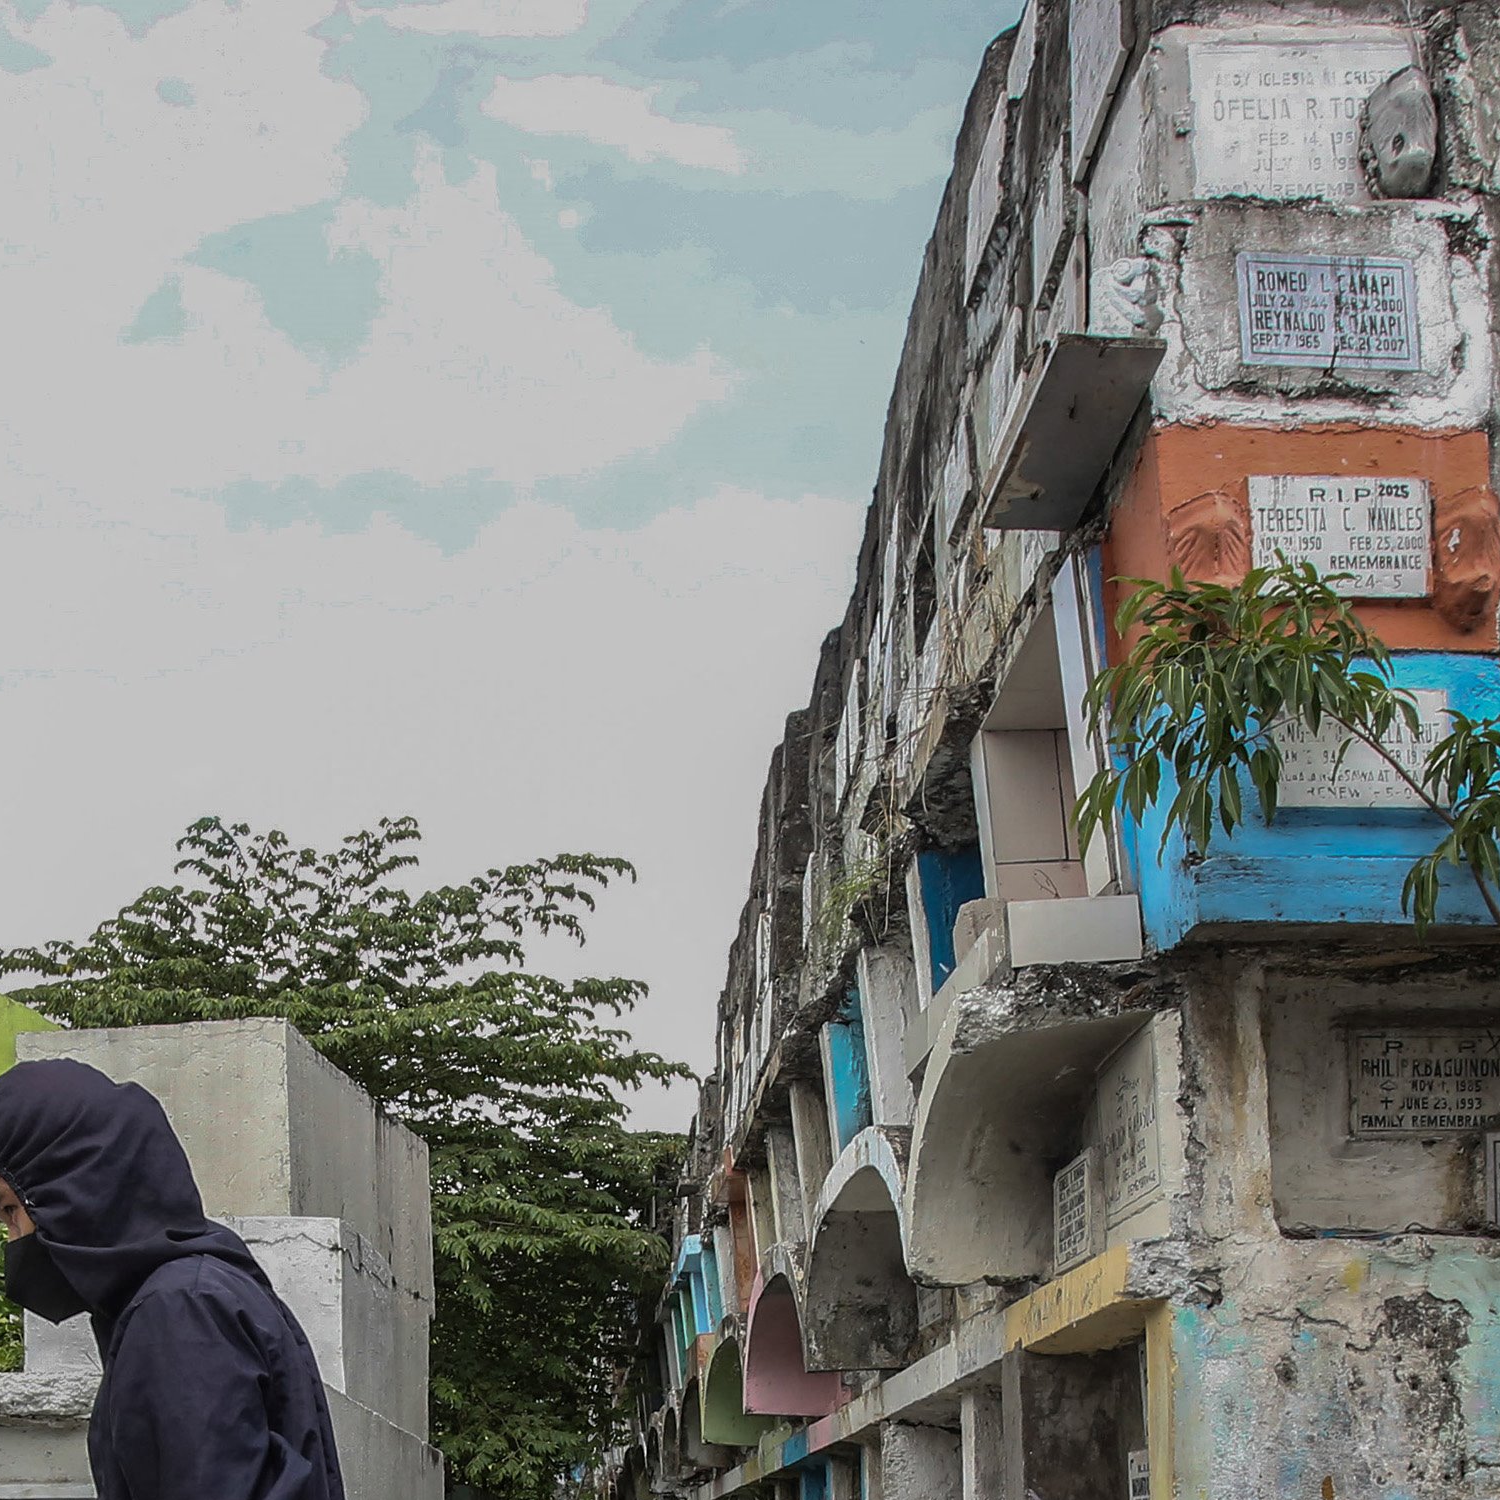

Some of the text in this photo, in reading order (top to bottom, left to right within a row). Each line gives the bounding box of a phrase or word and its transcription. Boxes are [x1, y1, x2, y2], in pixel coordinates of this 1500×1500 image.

[1213, 97, 1291, 121] OFELIA
[1257, 270, 1308, 292] ROMEO
[1252, 294, 1277, 309] JULY
[1280, 294, 1296, 309] 24
[1375, 299, 1404, 314] 2000
[1255, 310, 1326, 333] REYNALDO
[1296, 334, 1322, 349] 1965
[1375, 338, 1405, 352] 2007
[1377, 483, 1411, 499] 2025
[1257, 507, 1328, 532] TERESITA
[1367, 507, 1424, 532] NAVALES
[1329, 554, 1422, 570] REMEMBRANCE
[1378, 770, 1390, 783] AT
[1399, 1097, 1429, 1110] JUNE
[1455, 1097, 1483, 1110] 1993
[1361, 1115, 1405, 1128] FAMILY
